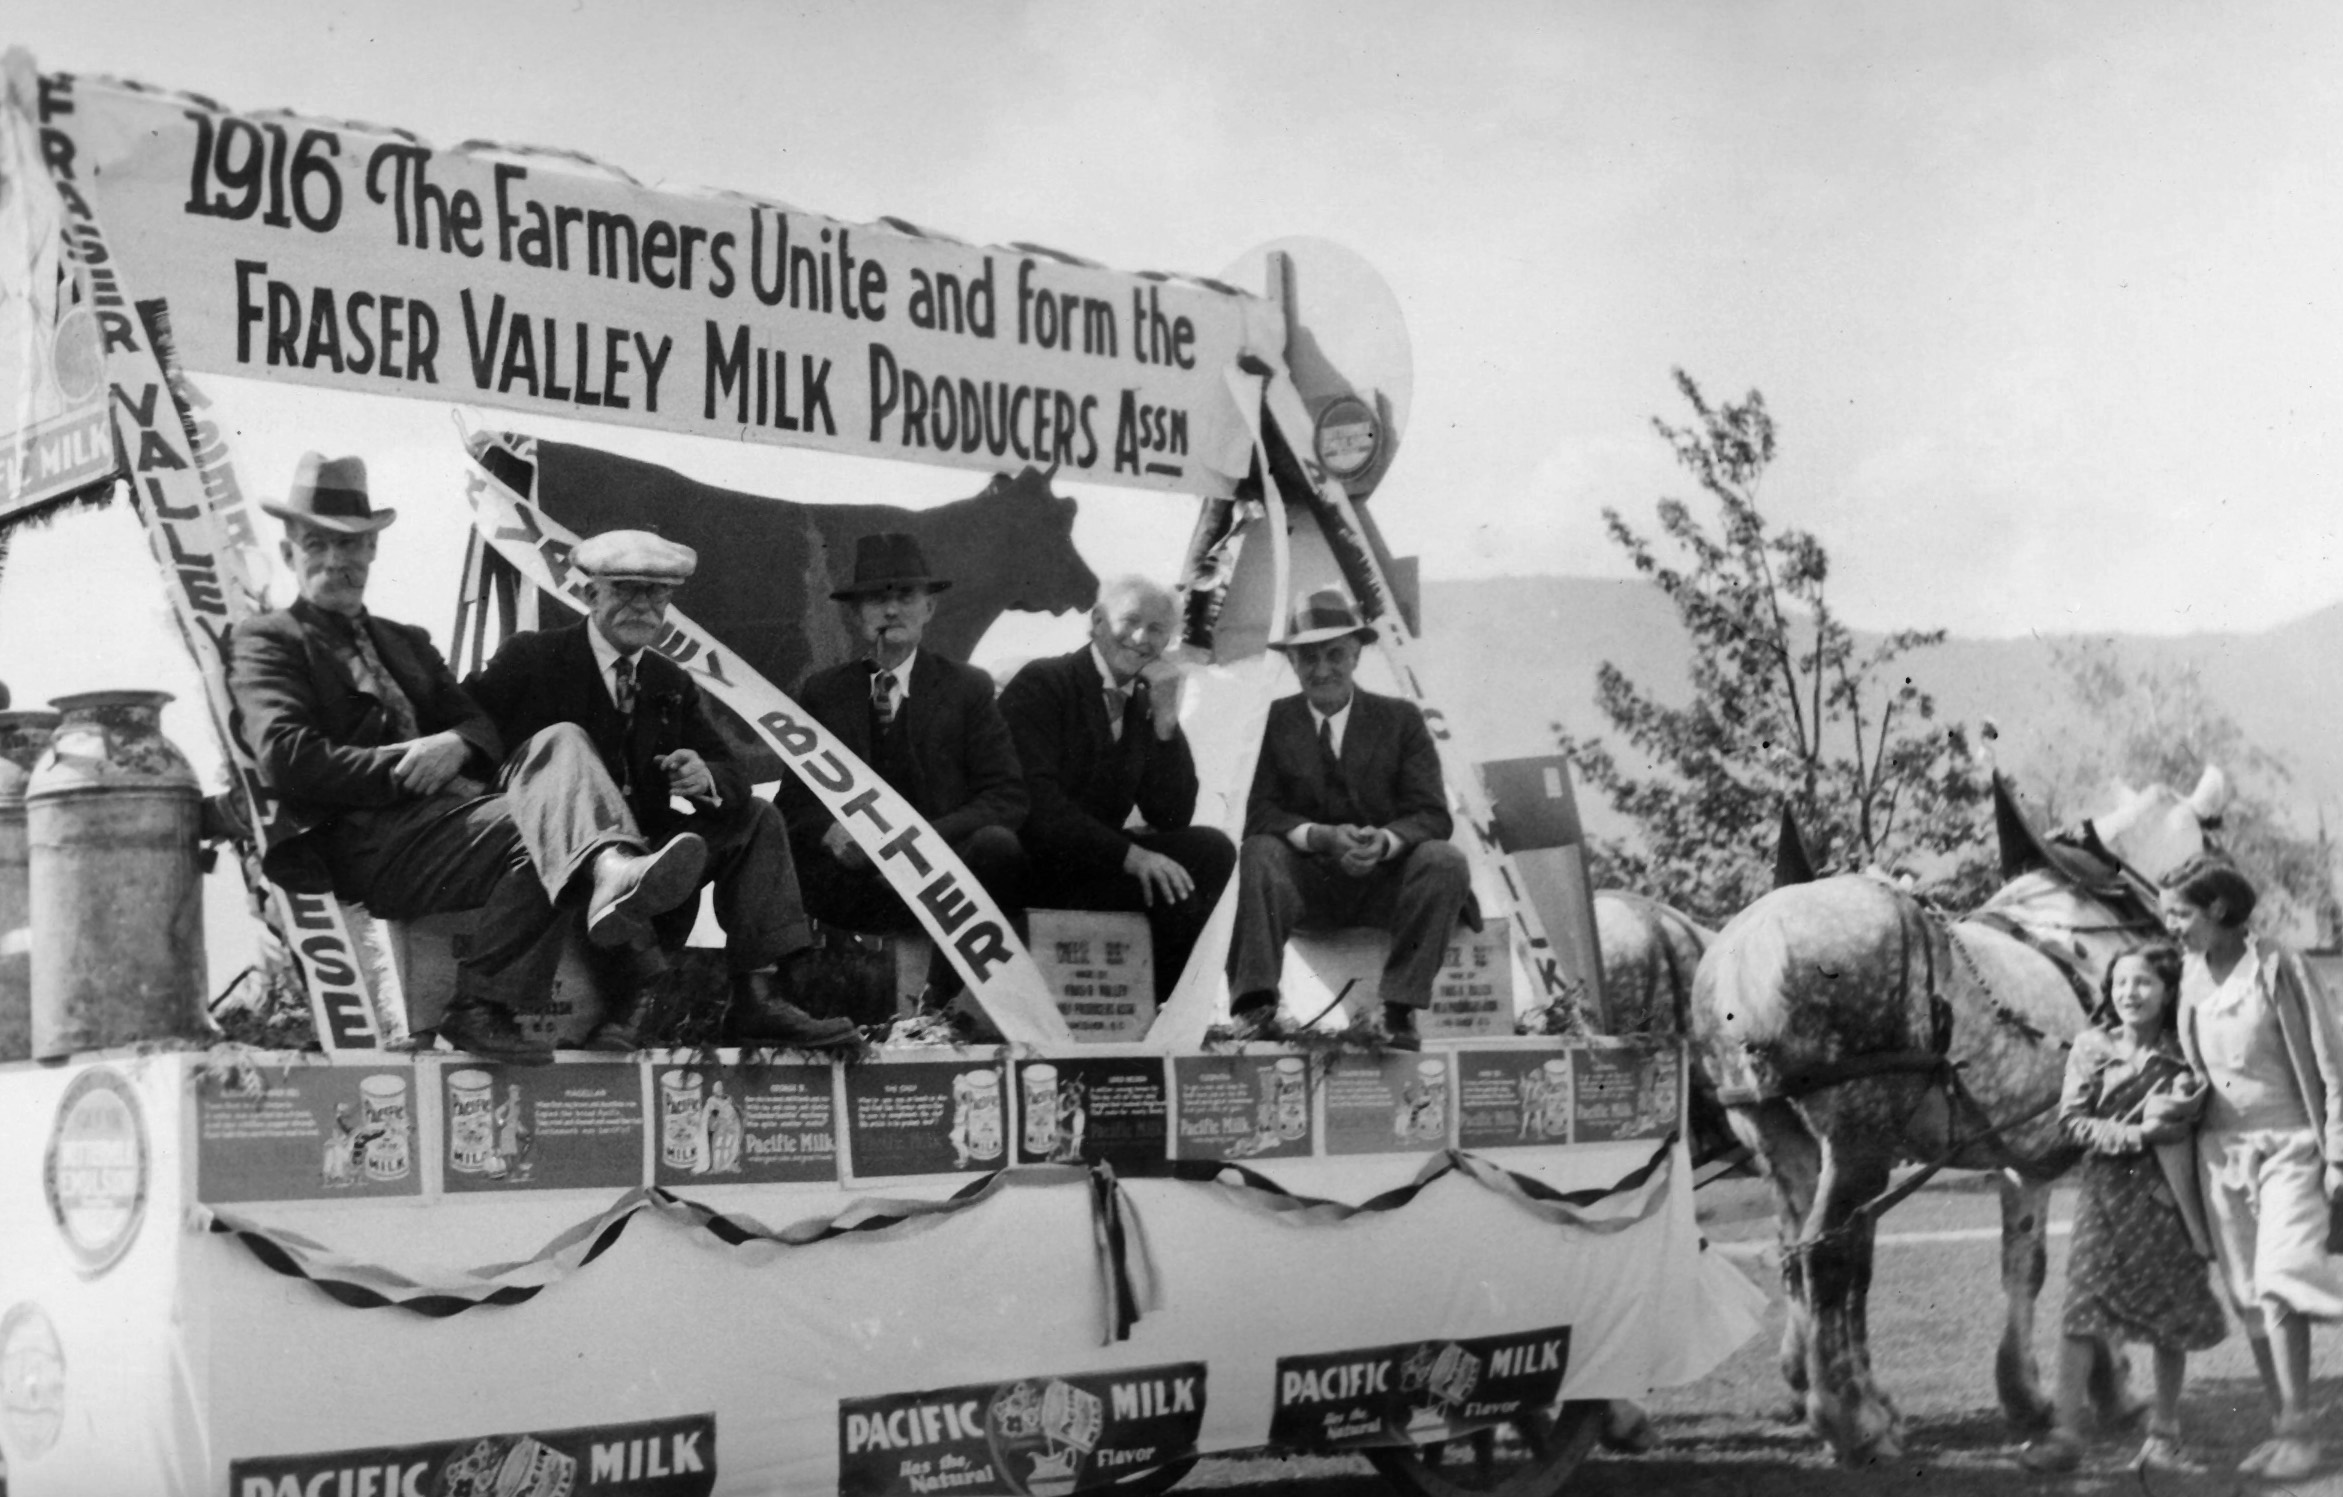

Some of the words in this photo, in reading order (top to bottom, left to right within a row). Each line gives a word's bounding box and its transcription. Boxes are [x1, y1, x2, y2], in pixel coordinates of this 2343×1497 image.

[183, 111, 343, 233] 1916
[365, 143, 484, 258] The
[494, 163, 736, 299] Farmers
[750, 208, 888, 322] Unite
[909, 256, 996, 340] and
[1018, 258, 1118, 359] form
[1134, 286, 1196, 370] the
[37, 75, 141, 354] FRASER
[109, 382, 236, 682] VALLEY
[234, 258, 440, 384] FRASER
[460, 288, 673, 412] VALLEY
[705, 320, 837, 436] MILK
[869, 342, 1099, 470] PRODUCERS
[39, 420, 110, 479] MILK
[757, 710, 1014, 984] BUTTER
[1282, 1360, 1393, 1406] PACIFIC
[1488, 1340, 1562, 1379] MILK
[846, 1400, 986, 1453] PACIFIC
[1110, 1377, 1196, 1421] MILK
[590, 1431, 704, 1485] MILK
[908, 1464, 995, 1494] Natural
[1097, 1446, 1157, 1468] Flavor
